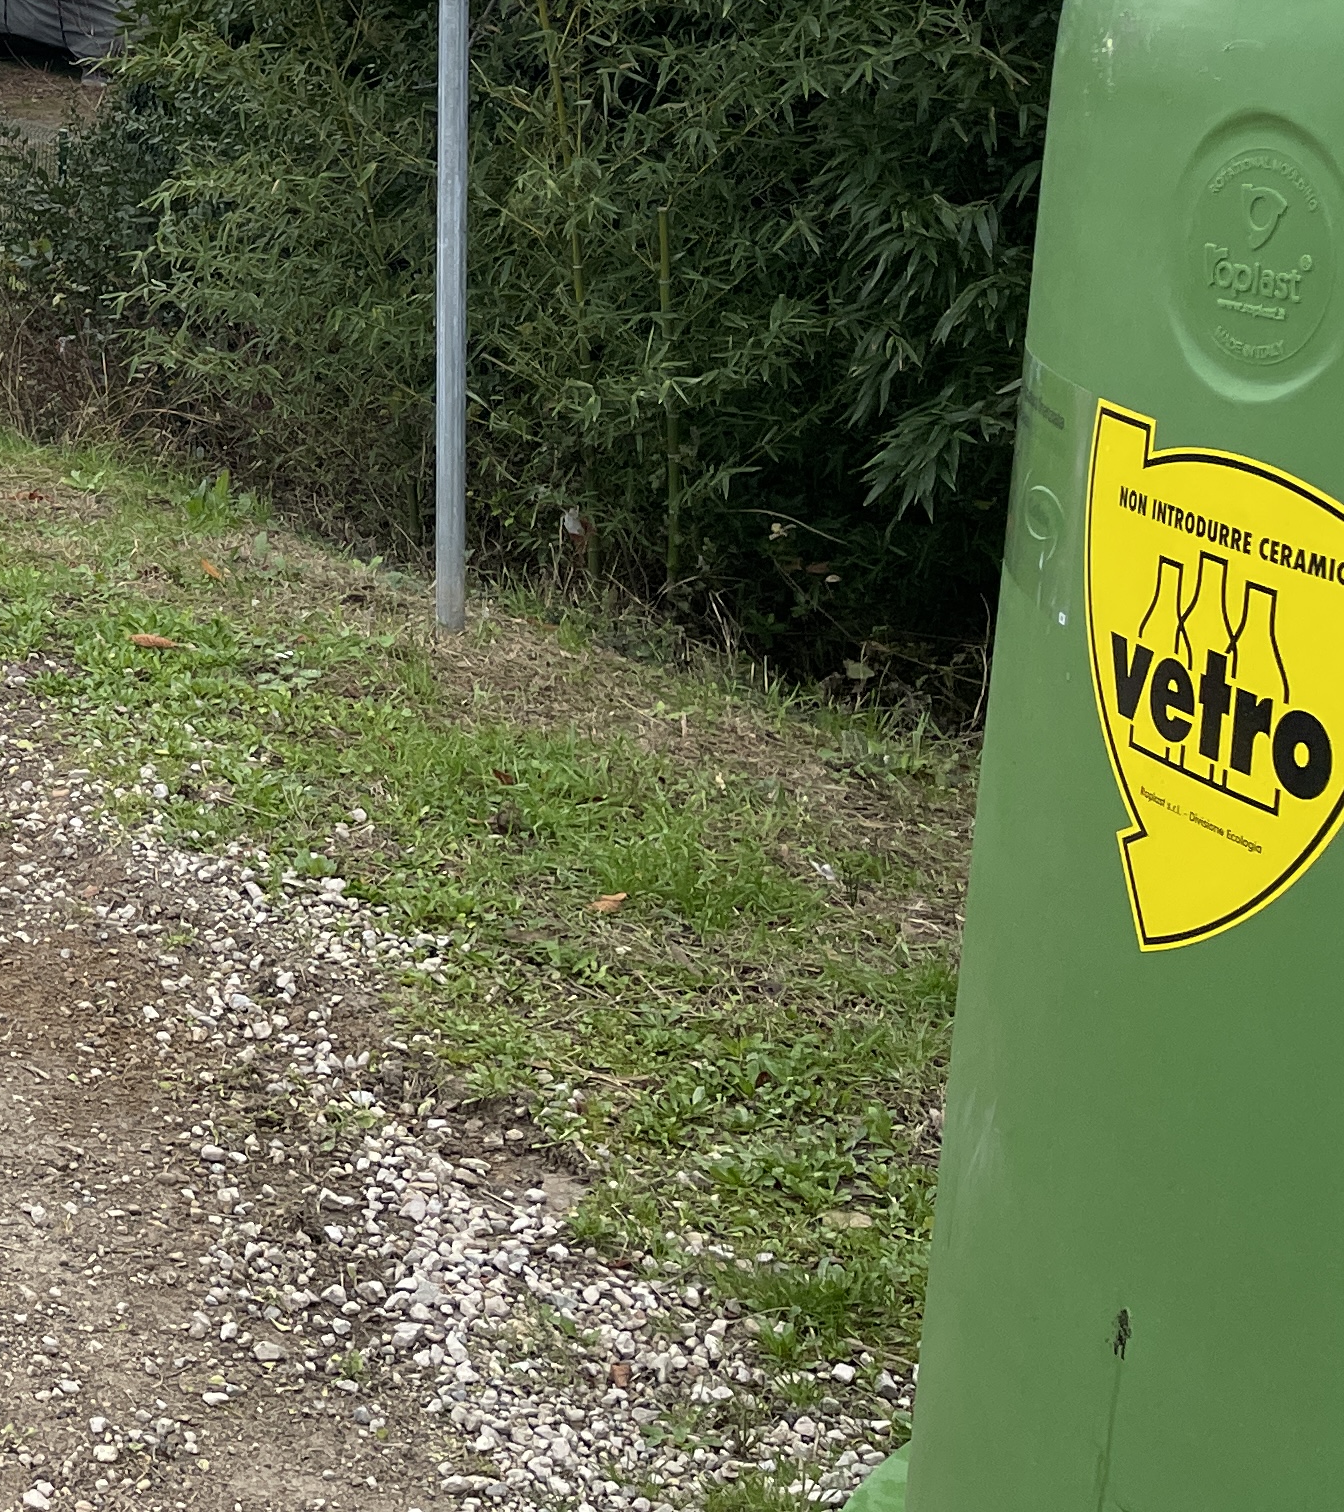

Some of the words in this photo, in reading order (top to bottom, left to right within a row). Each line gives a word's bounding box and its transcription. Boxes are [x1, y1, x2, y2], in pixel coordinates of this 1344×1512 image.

[1119, 486, 1147, 517] NON
[1152, 498, 1253, 555] INTRODURRE
[1111, 631, 1333, 800] vetro
[1189, 811, 1224, 837] Divisione
[1226, 829, 1262, 854] Ecologia
